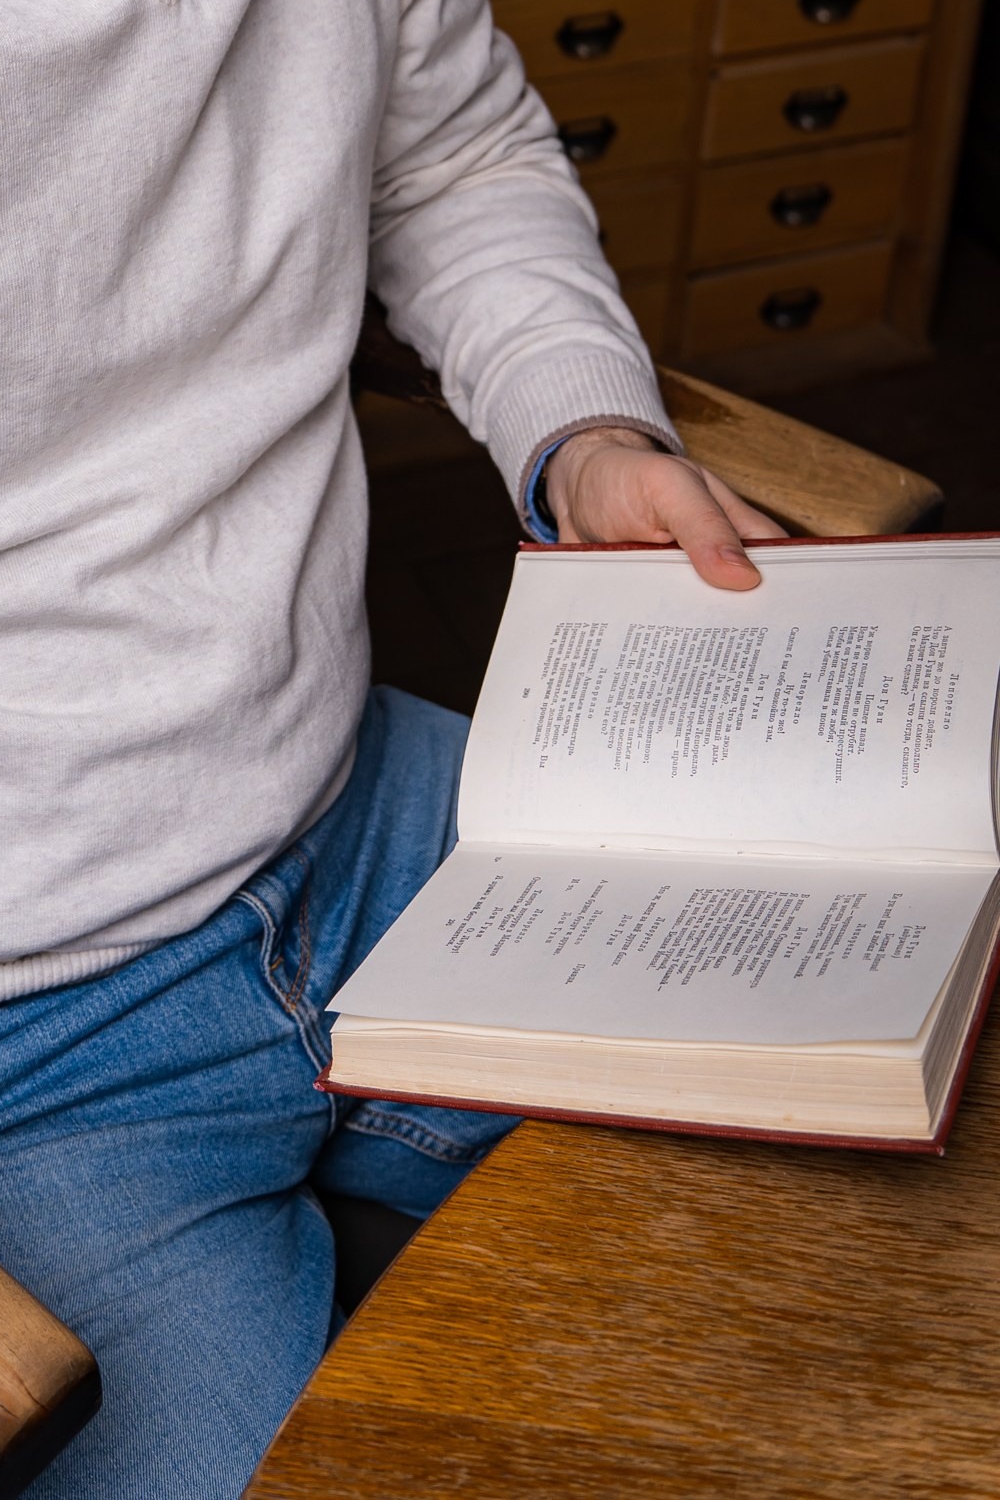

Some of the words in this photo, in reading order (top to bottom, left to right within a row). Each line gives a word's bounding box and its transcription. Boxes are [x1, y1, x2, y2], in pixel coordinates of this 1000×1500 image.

[701, 628, 711, 637] На
[720, 628, 730, 639] Вот
[739, 628, 749, 640] Что
[749, 628, 759, 636] Не
[756, 627, 768, 646] Слуга
[786, 627, 799, 651] Сидели
[826, 626, 838, 647] Семья
[836, 626, 848, 648] Чтобы
[846, 626, 858, 644] Меня
[857, 626, 868, 642] Ведь
[868, 626, 878, 637] Уж
[912, 626, 921, 636] Он
[932, 626, 942, 639] Что
[695, 640, 706, 663] первых
[712, 642, 724, 667] видишь
[720, 636, 735, 671] женщины?
[743, 639, 753, 654] умер
[844, 647, 851, 655] он
[853, 652, 860, 660] не
[863, 640, 873, 660] верно
[907, 645, 915, 662] вами
[917, 635, 930, 661] Мадрит
[929, 642, 939, 656] Дон
[938, 635, 948, 658] завтра
[729, 652, 740, 673] земля!
[740, 657, 748, 669] там
[781, 660, 788, 669] вы
[831, 651, 840, 668] меня
[925, 660, 936, 678] Гуан
[936, 662, 944, 672] же
[706, 669, 716, 679] ли,
[717, 674, 726, 683] Да
[737, 671, 744, 679] со
[777, 672, 785, 686] себе
[836, 658, 848, 685] удалил,
[857, 663, 868, 688] головы
[901, 664, 912, 695] сделает?
[910, 664, 922, 691] явился,
[934, 676, 941, 684] до
[683, 666, 698, 700] тамошних
[704, 682, 712, 695] мой
[731, 681, 741, 704] скуки.
[757, 674, 769, 691] Дон
[783, 685, 795, 695] Ну
[823, 671, 835, 702] оставила
[881, 676, 893, 694] Дон
[923, 681, 929, 689] из
[588, 668, 607, 719] Лепорелло
[712, 694, 719, 702] не
[720, 685, 733, 709] небо?..
[793, 672, 811, 724] Лепорелло
[833, 688, 842, 706] меня
[854, 691, 862, 704] мне
[930, 688, 939, 715] короля
[943, 674, 959, 729] Лепорелло
[697, 697, 708, 725] глупый
[727, 707, 737, 721] Что
[751, 696, 764, 719] Гуан
[769, 688, 781, 722] спокойно
[780, 698, 789, 716] то-то
[852, 708, 859, 717] не
[862, 694, 874, 724] Пошлет
[876, 699, 889, 723] Гуан
[918, 692, 927, 720] ссылки
[674, 702, 687, 737] красавиц
[714, 712, 724, 741] точный
[725, 724, 732, 732] за
[777, 720, 785, 734] же!
[818, 713, 826, 736] покое
[826, 719, 838, 743] любя;
[847, 720, 857, 755] отрубят.
[857, 728, 867, 754] назад.
[903, 719, 913, 743] тогда,
[924, 719, 935, 750] дойдет,
[720, 735, 730, 760] люди,
[671, 750, 679, 778] право.
[900, 747, 911, 788] скажите,
